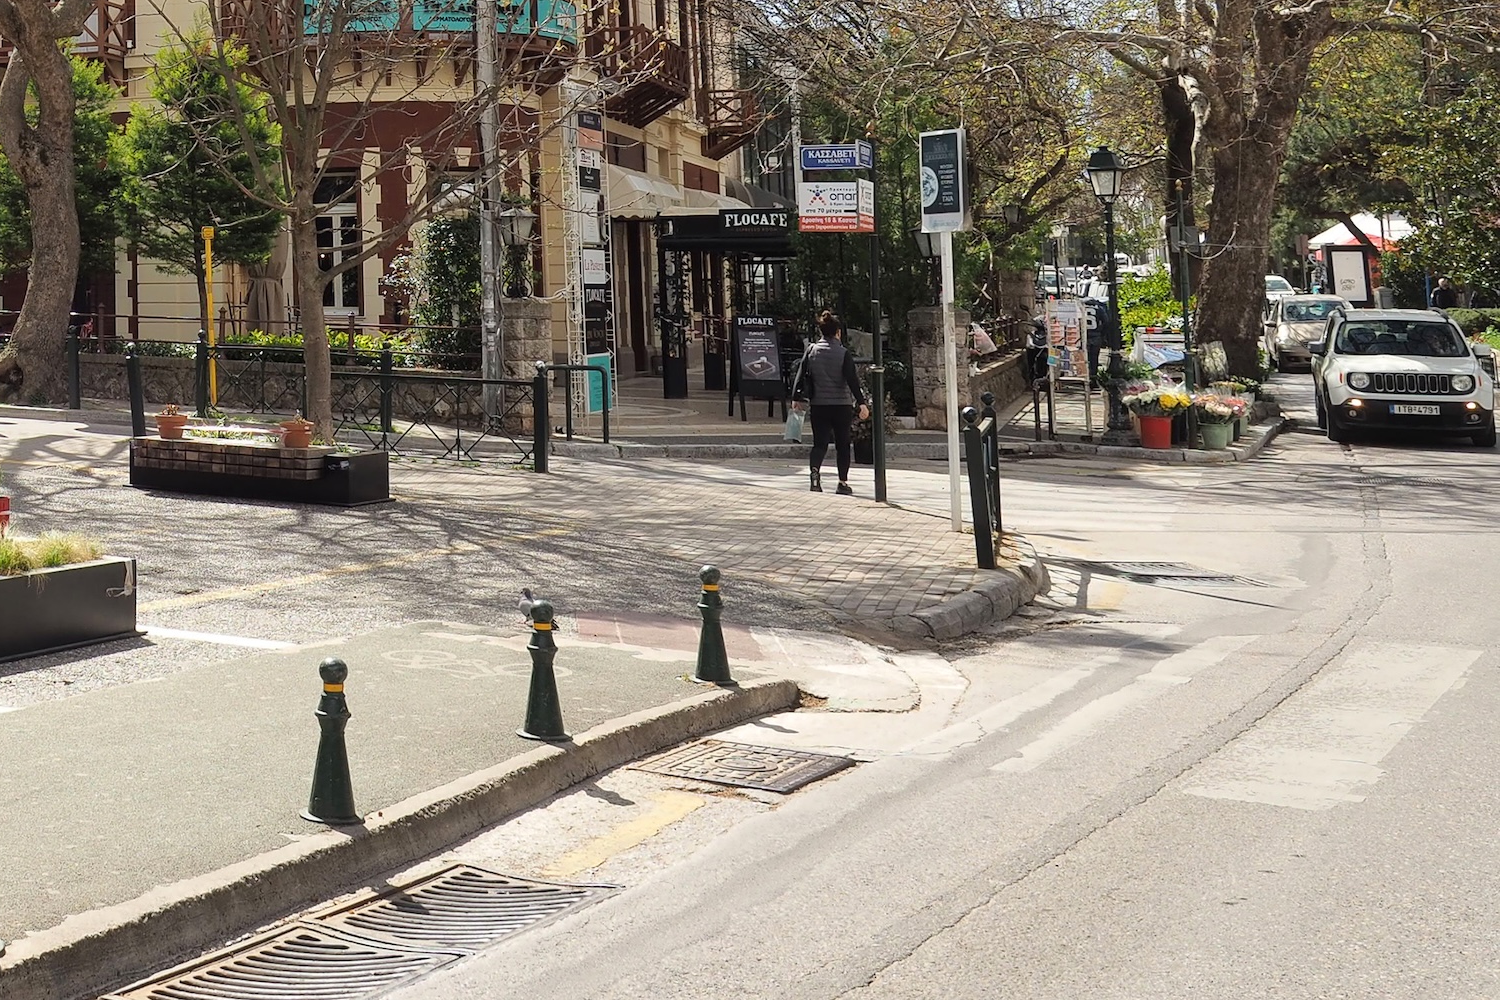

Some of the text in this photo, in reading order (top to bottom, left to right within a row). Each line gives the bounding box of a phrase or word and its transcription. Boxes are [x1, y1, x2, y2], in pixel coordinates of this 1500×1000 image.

[808, 149, 856, 159] ΚΑΣΣΑΒΕΤ
[724, 213, 788, 227] FLOCAFE
[738, 317, 774, 326] FLOCAFE
